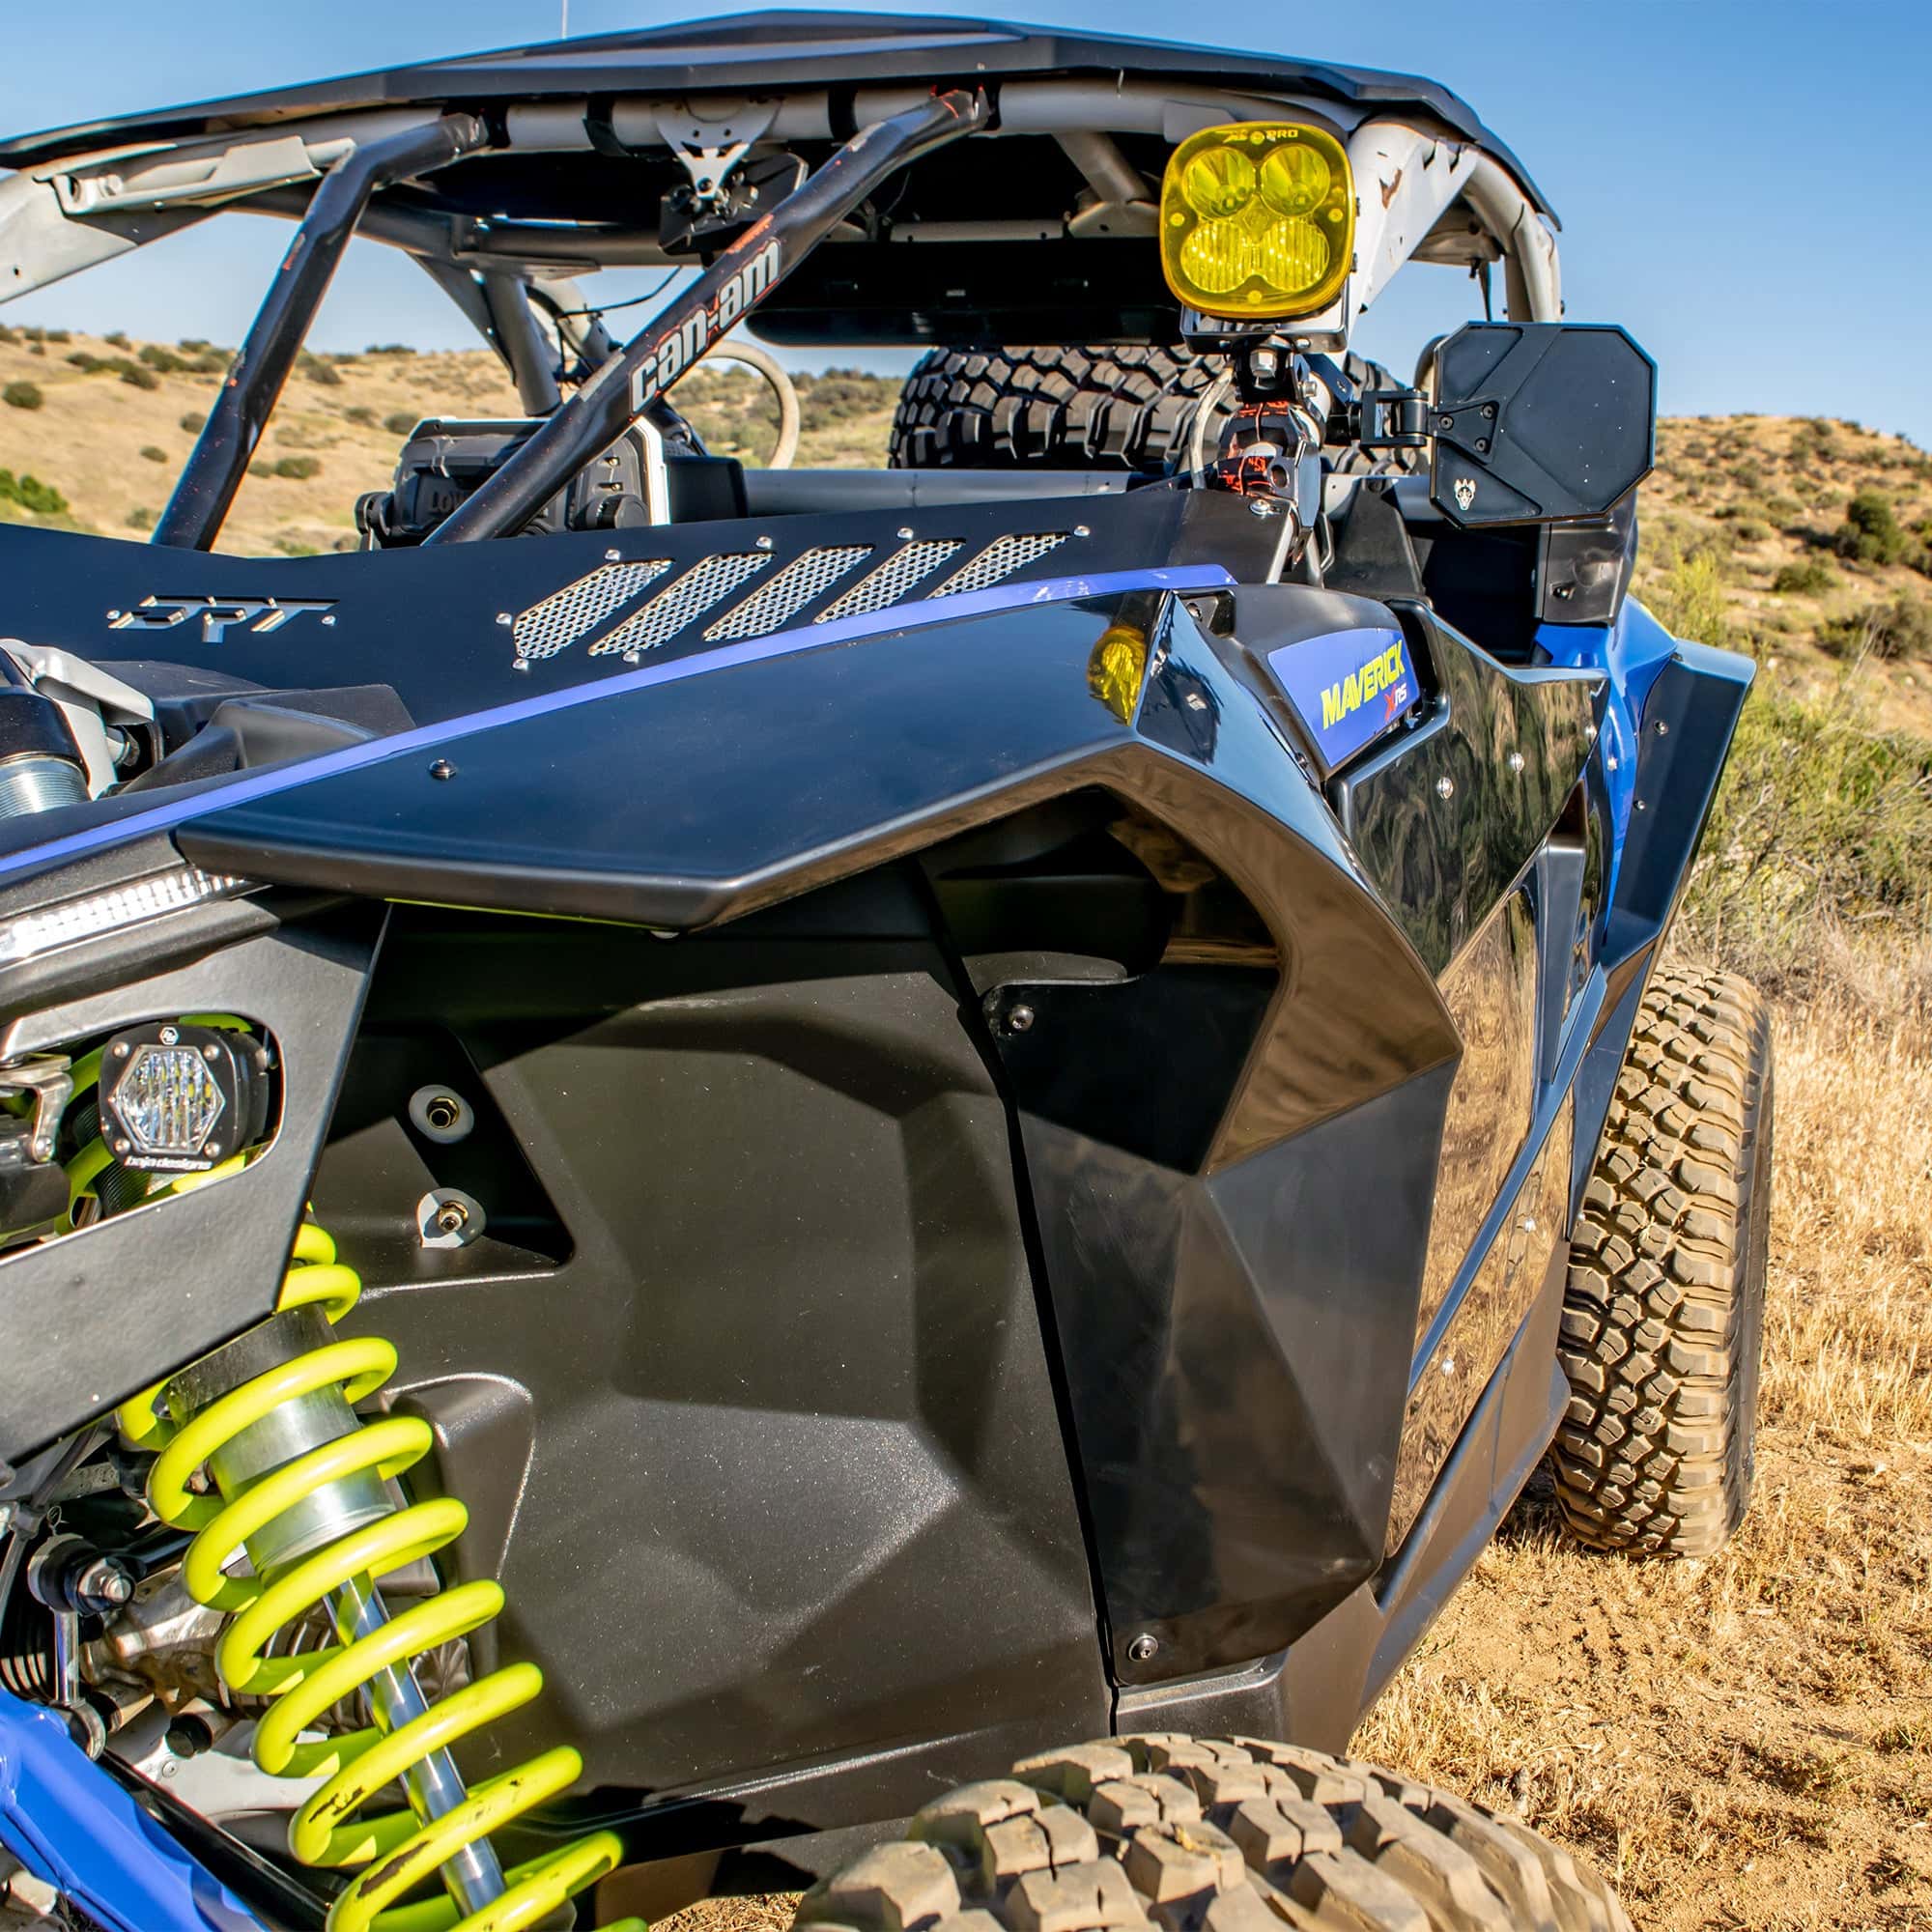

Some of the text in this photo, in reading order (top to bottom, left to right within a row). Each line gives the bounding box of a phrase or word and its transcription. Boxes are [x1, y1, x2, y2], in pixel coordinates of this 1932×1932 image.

[1266, 128, 1298, 141] PRO
[631, 241, 781, 412] can-am
[1320, 639, 1406, 731] MAVERICK
